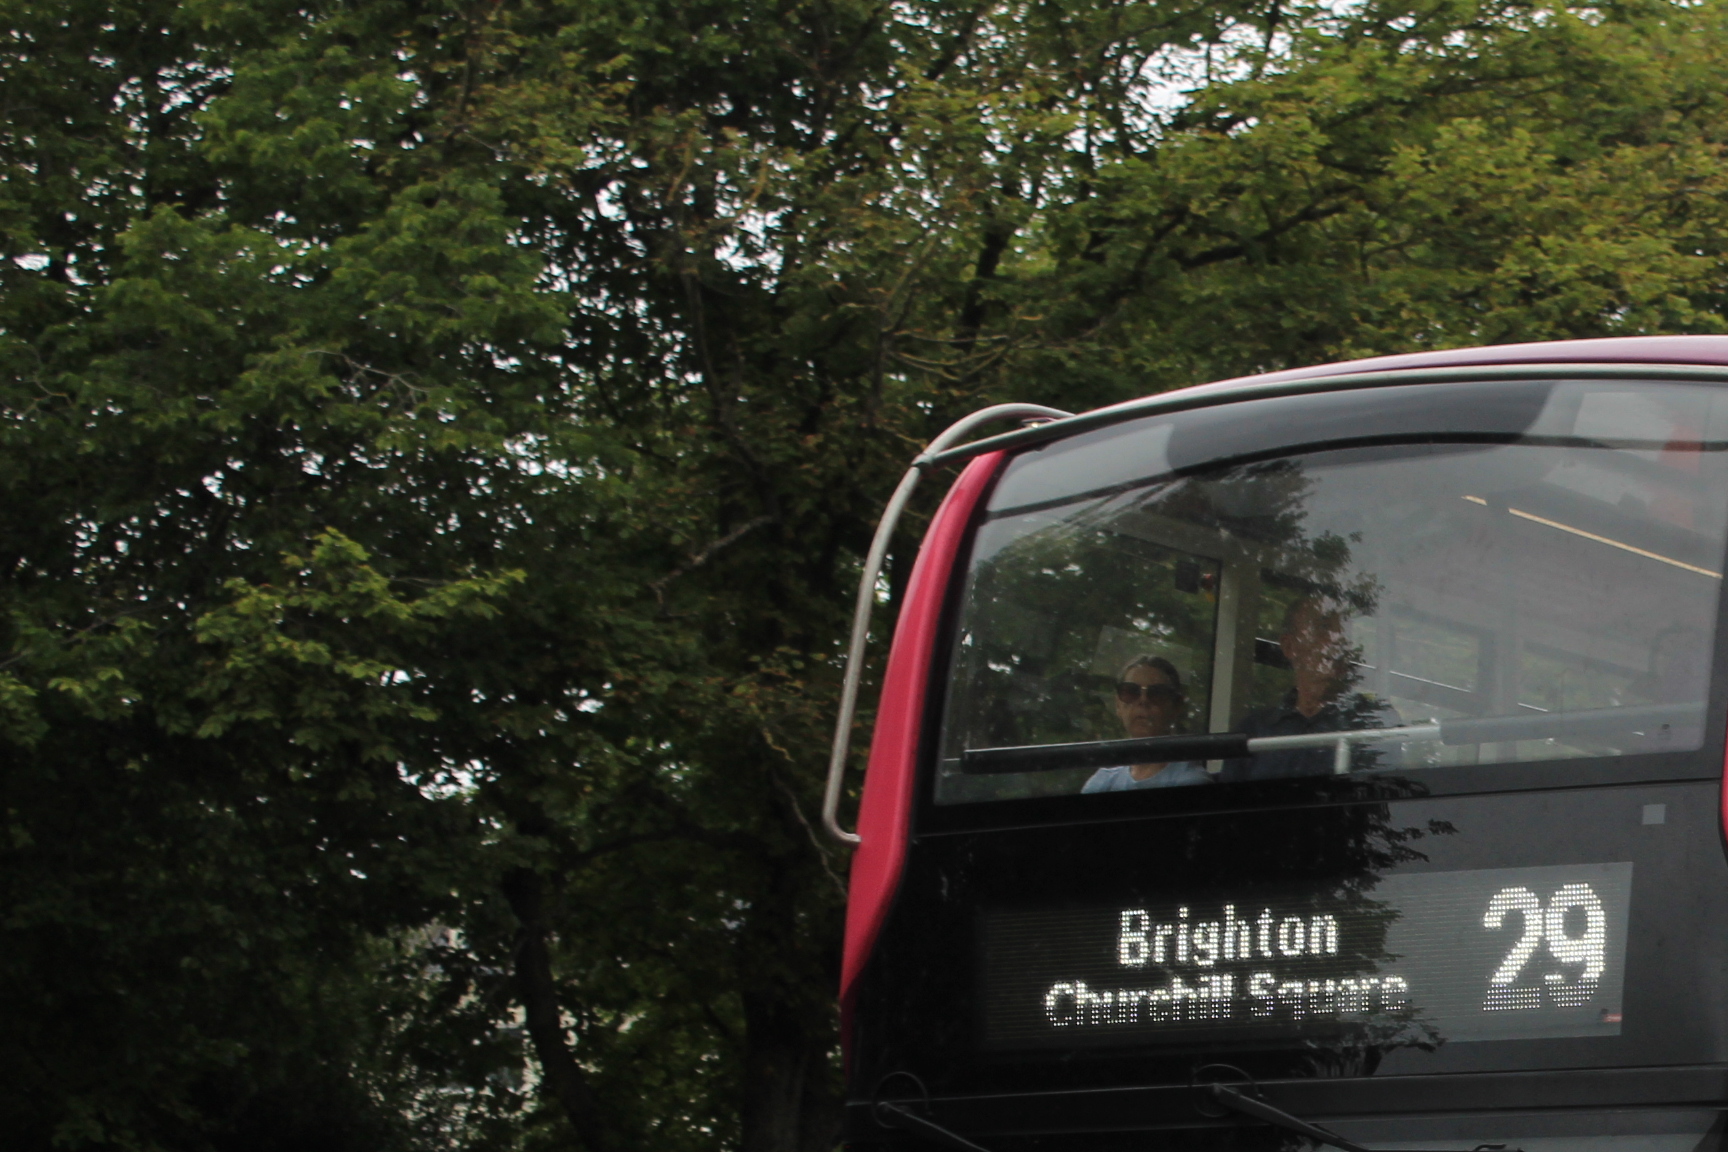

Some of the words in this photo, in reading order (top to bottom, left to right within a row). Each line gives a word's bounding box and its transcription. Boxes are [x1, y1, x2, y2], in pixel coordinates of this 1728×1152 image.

[1117, 903, 1339, 968] Brighton
[1482, 882, 1606, 1012] 29
[1044, 972, 1234, 1028] Churchill
[1248, 971, 1410, 1021] Square
